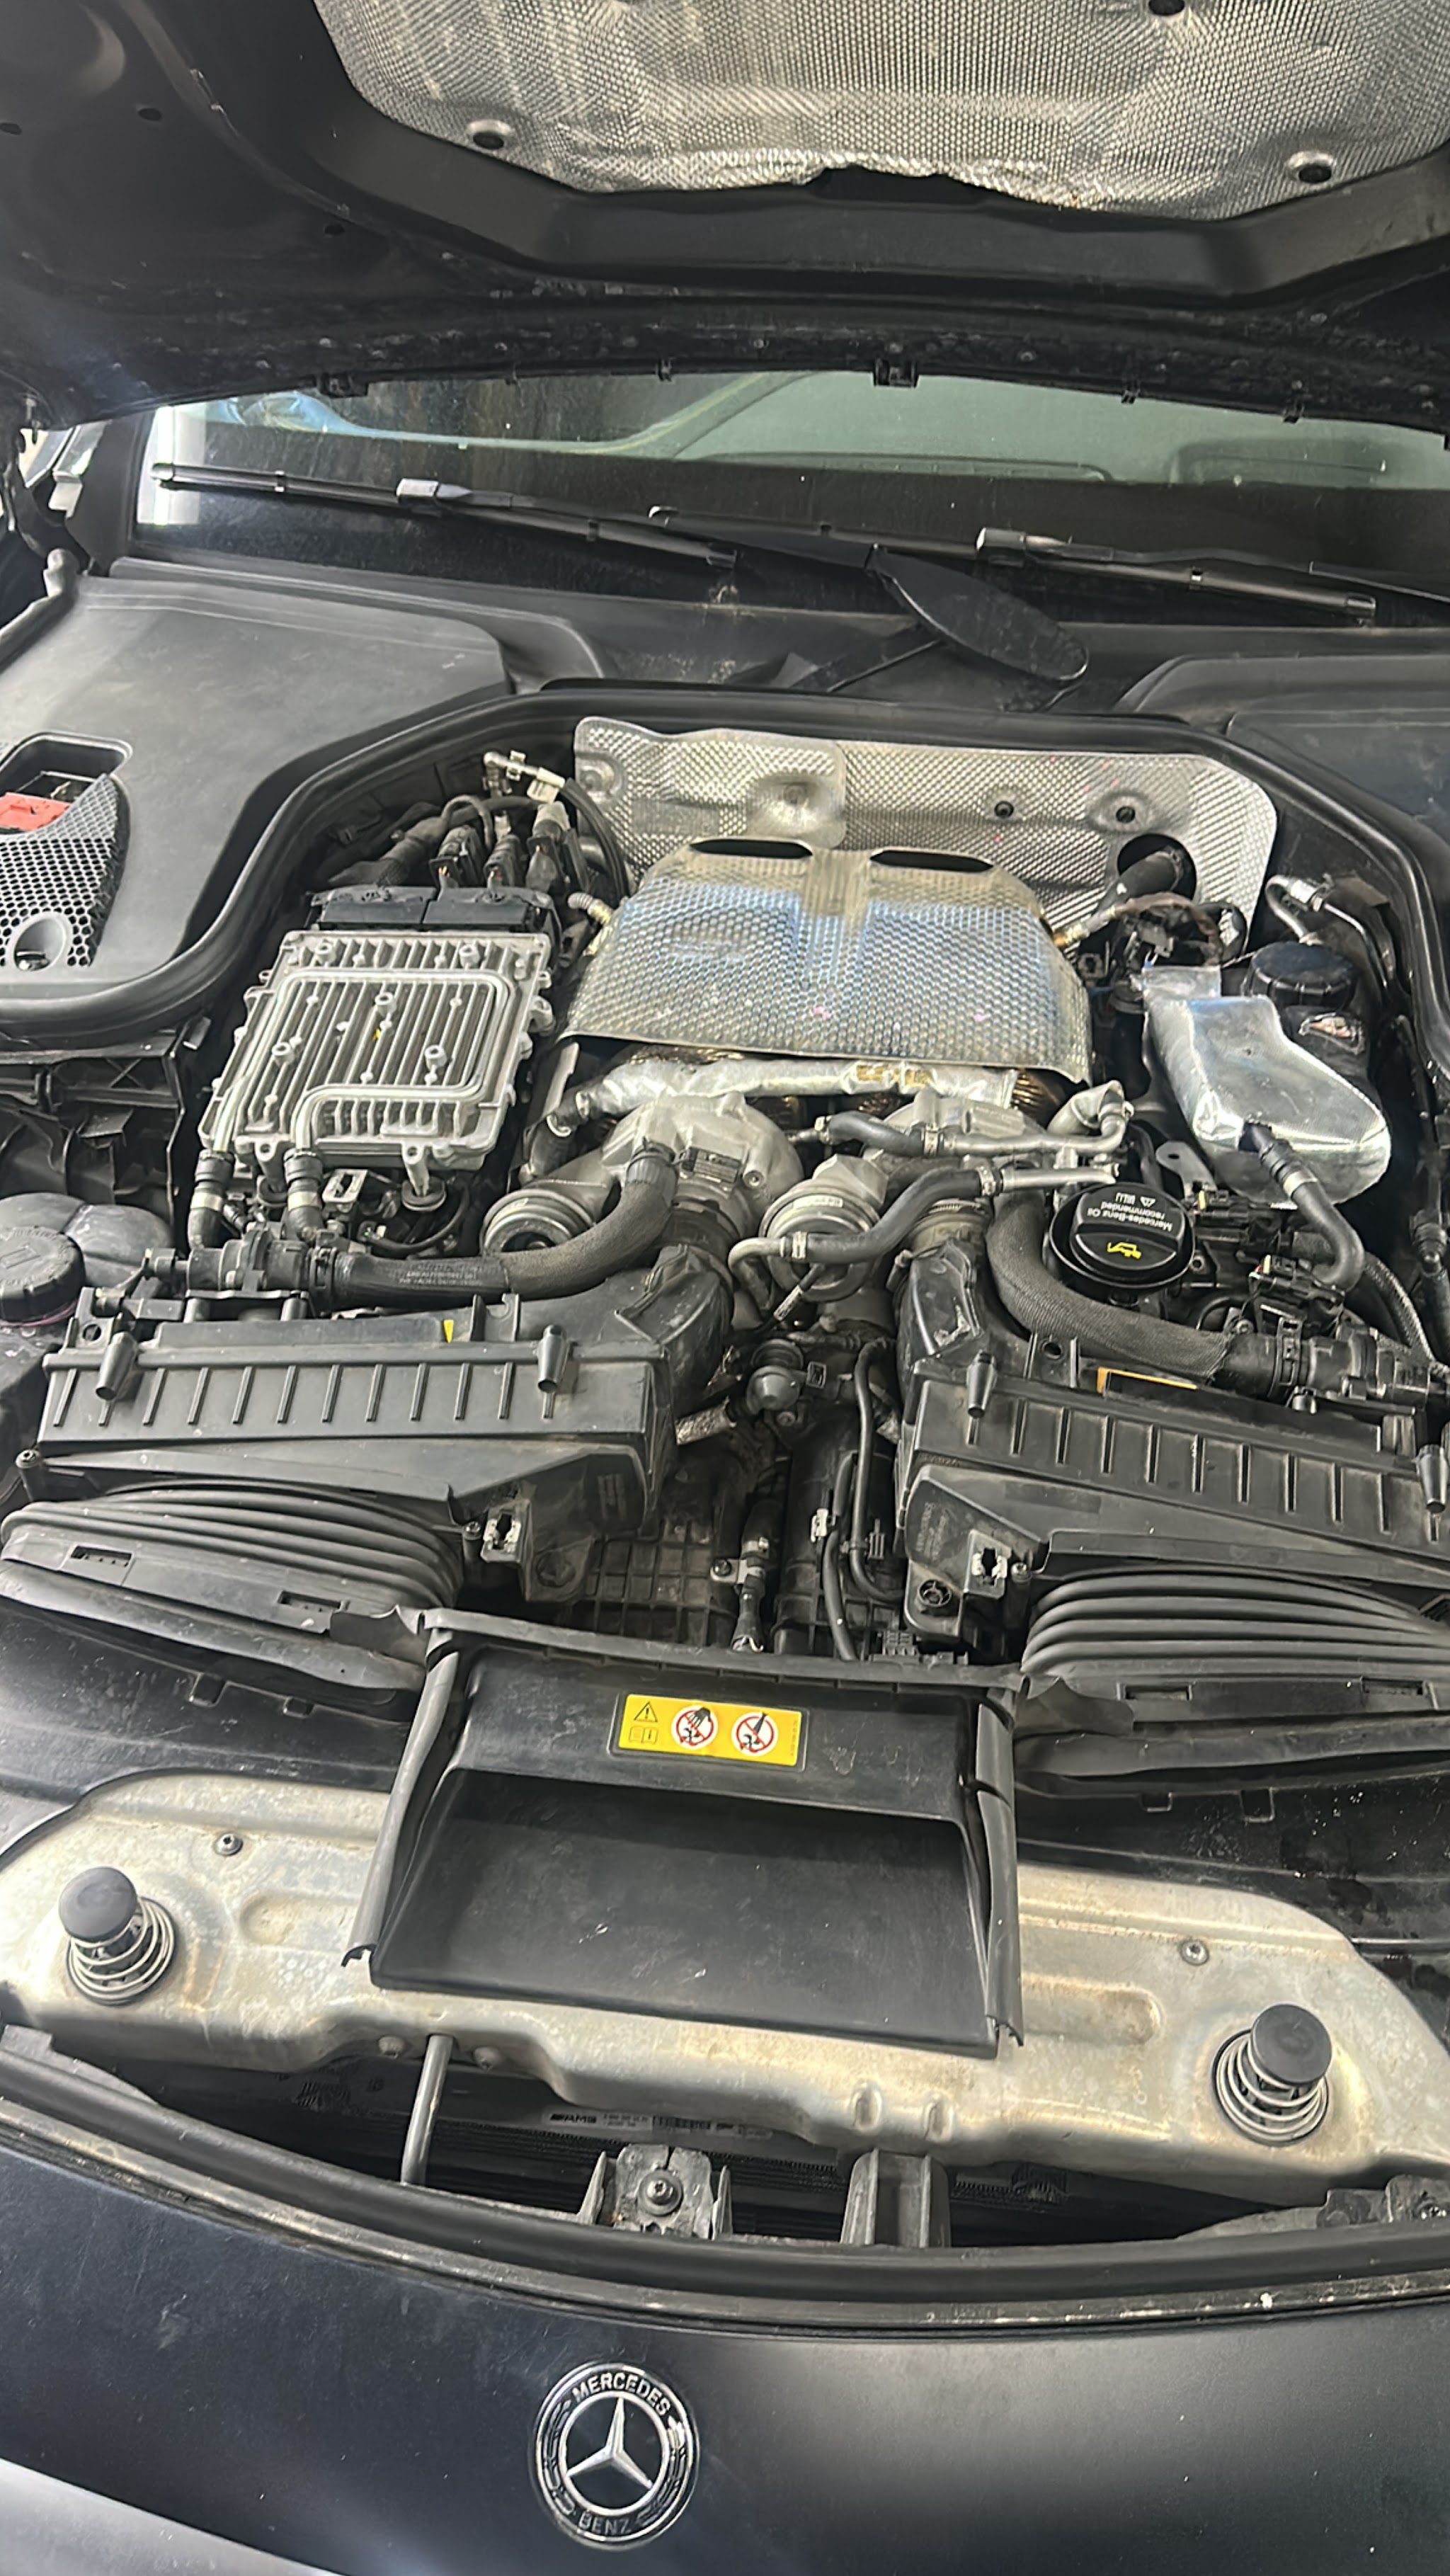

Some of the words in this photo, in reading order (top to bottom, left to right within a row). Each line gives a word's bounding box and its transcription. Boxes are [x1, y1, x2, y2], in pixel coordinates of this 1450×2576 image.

[1100, 1202, 1165, 1219] recommended
[1102, 1210, 1172, 1231] Mercedes-Benz
[571, 2372, 671, 2415] MERCEDES
[578, 2510, 632, 2534] BENZ
